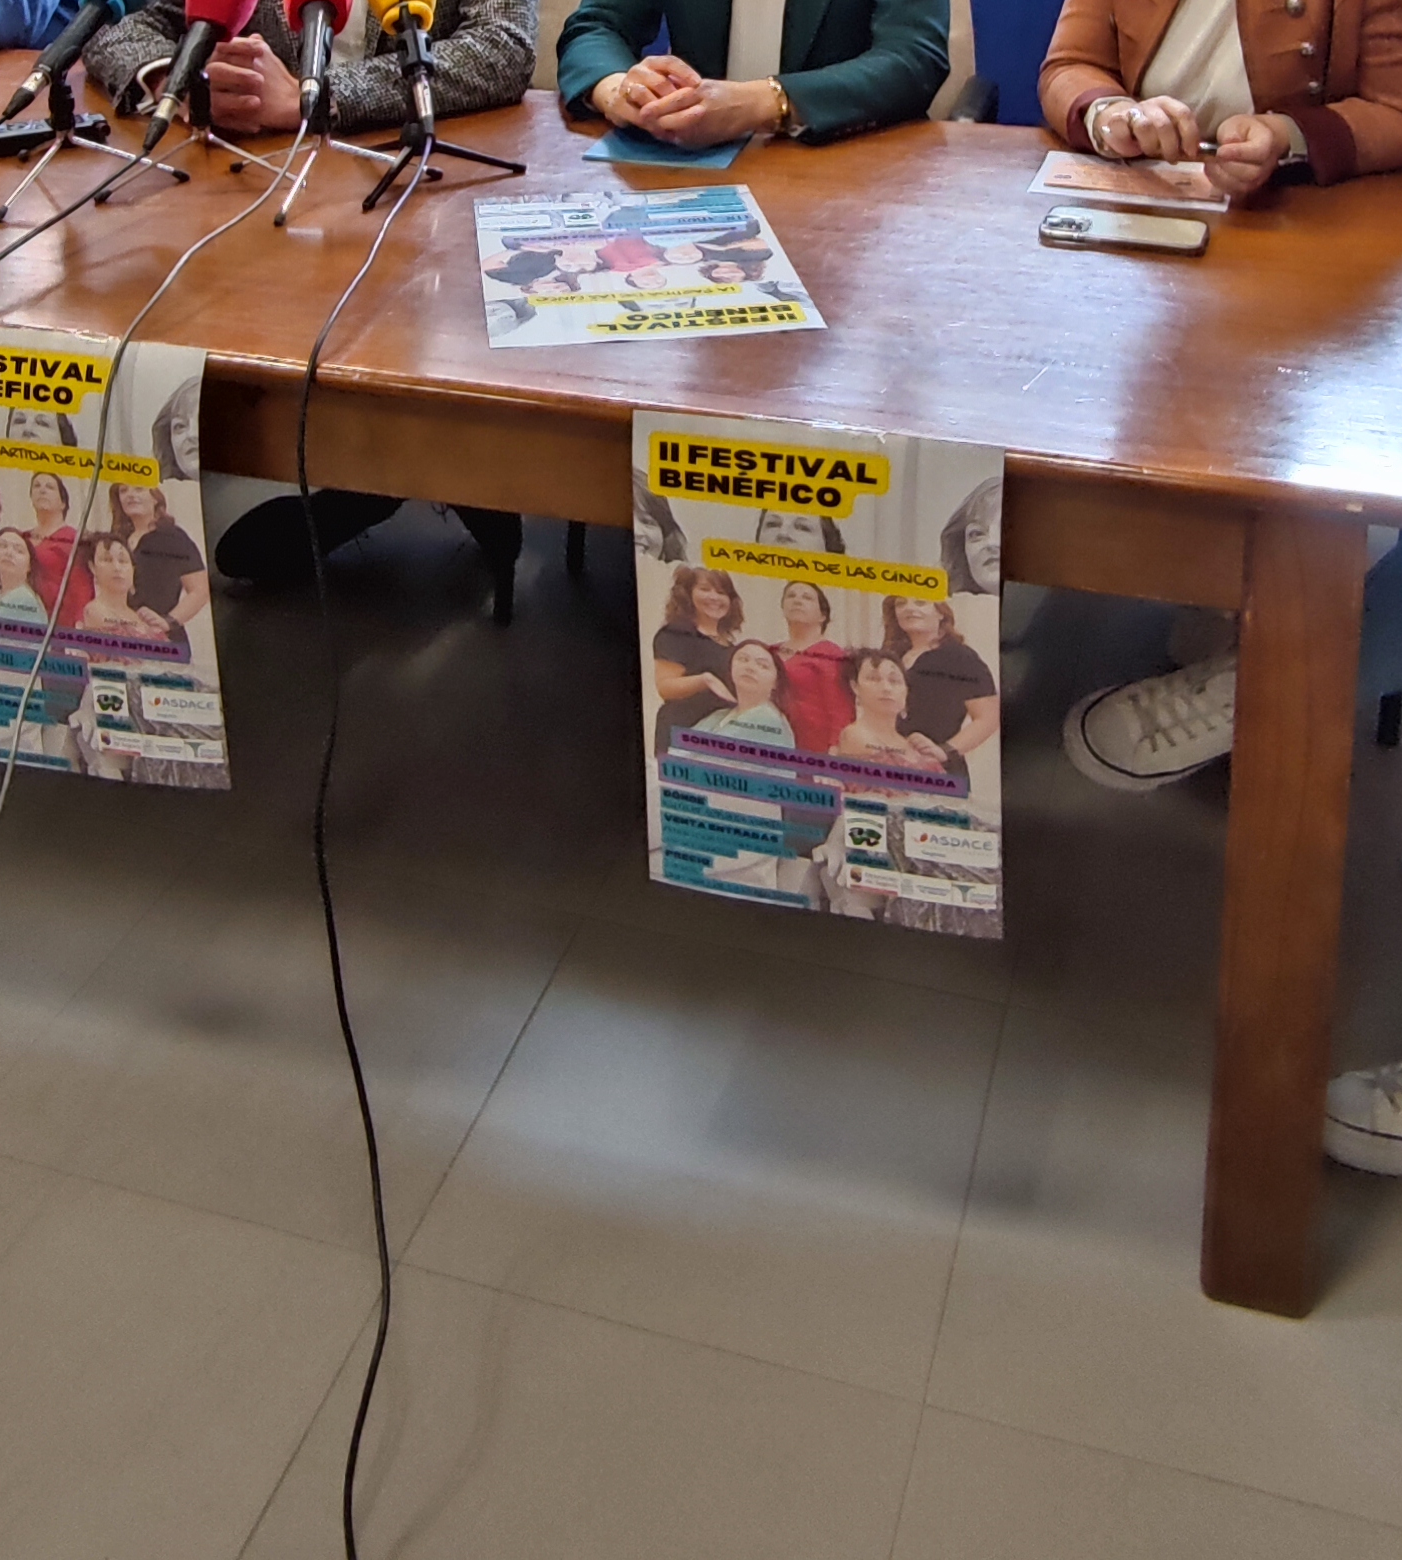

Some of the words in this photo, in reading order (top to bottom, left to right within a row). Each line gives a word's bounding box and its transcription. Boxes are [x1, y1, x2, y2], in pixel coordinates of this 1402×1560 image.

[597, 313, 770, 331] FESTIVAL
[52, 453, 76, 466] DE
[106, 459, 153, 477] CINCO
[659, 441, 679, 462] II
[687, 443, 878, 485] FESTIVAL
[659, 468, 842, 508] BENÉFICO
[709, 546, 730, 560] LA
[733, 548, 809, 570] PARTIDA
[812, 560, 842, 575] DE
[846, 565, 877, 580] LAS
[881, 569, 939, 589] CINCO
[121, 640, 180, 656] ENTRADA
[681, 733, 736, 751] SORTEO
[739, 744, 756, 756] DE
[759, 748, 825, 768] REGALOS
[829, 761, 861, 774] CON
[864, 767, 882, 778] LA
[885, 770, 956, 789] ENTRADA
[670, 764, 695, 783] DE
[703, 771, 750, 793] ABRIL
[767, 783, 835, 808] 20:00H
[664, 813, 705, 829] VENTA
[708, 821, 779, 843] ENTRADAS
[664, 849, 710, 866] PRECIO
